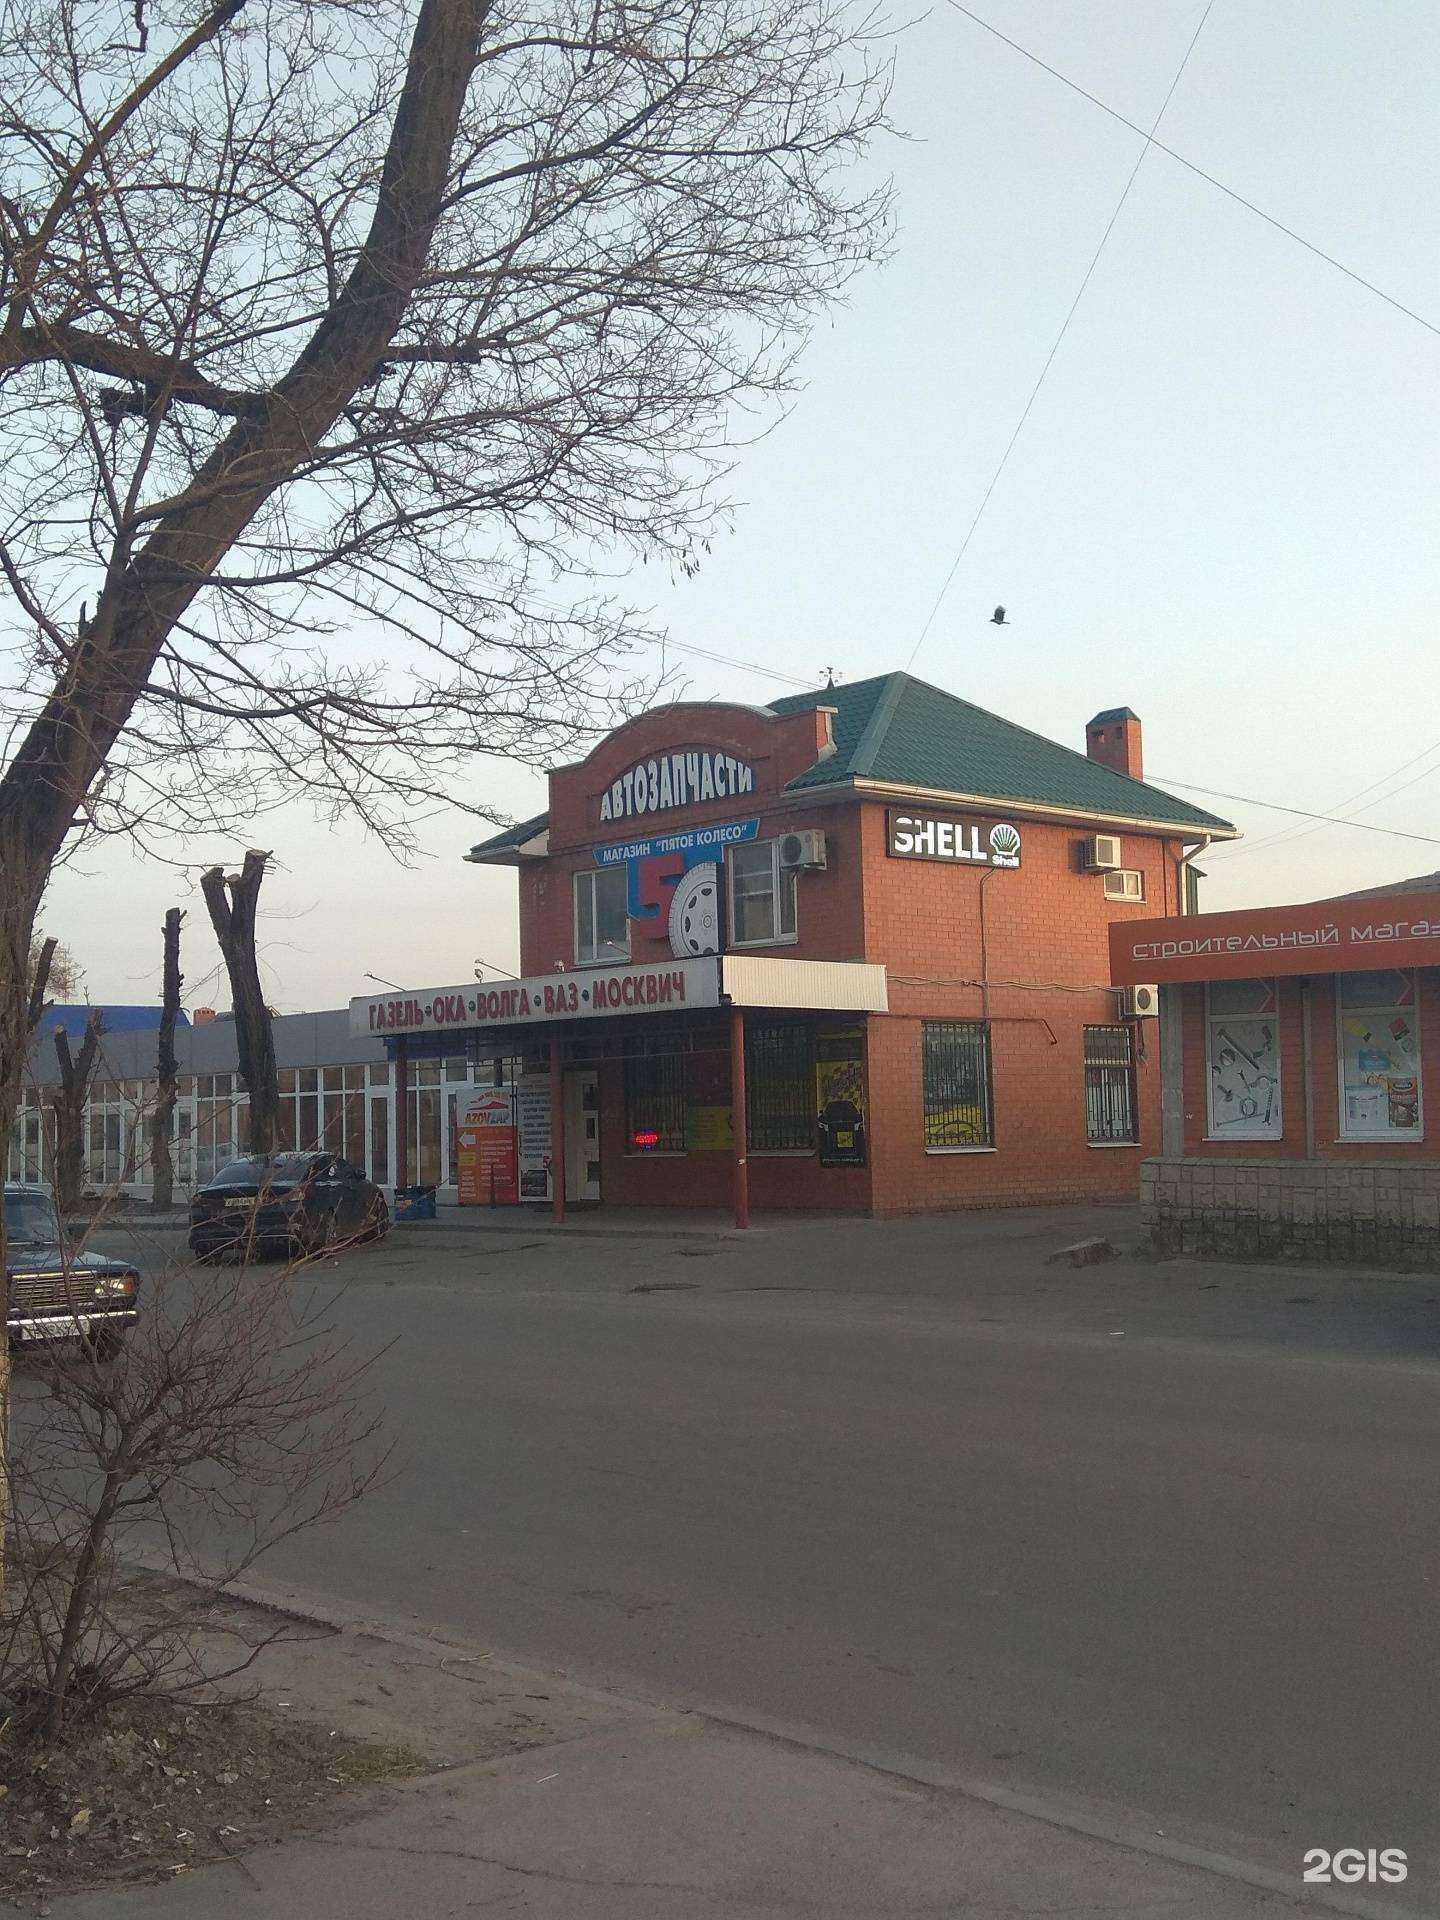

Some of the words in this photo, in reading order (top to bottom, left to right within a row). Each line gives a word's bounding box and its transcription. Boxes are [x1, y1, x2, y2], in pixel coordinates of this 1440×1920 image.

[600, 752, 753, 820] АВТОЗАПЧАСТИ
[603, 842, 650, 862] МАГАЗИН
[895, 817, 988, 860] SHELL
[1132, 923, 1340, 958] строительный
[368, 999, 424, 1031] ГАЗЕЛЬ
[432, 994, 467, 1024] ОКА
[476, 988, 531, 1020] ВОЛГА
[543, 982, 579, 1014] ВАЗ
[592, 971, 686, 1009] МОСКВИЧ
